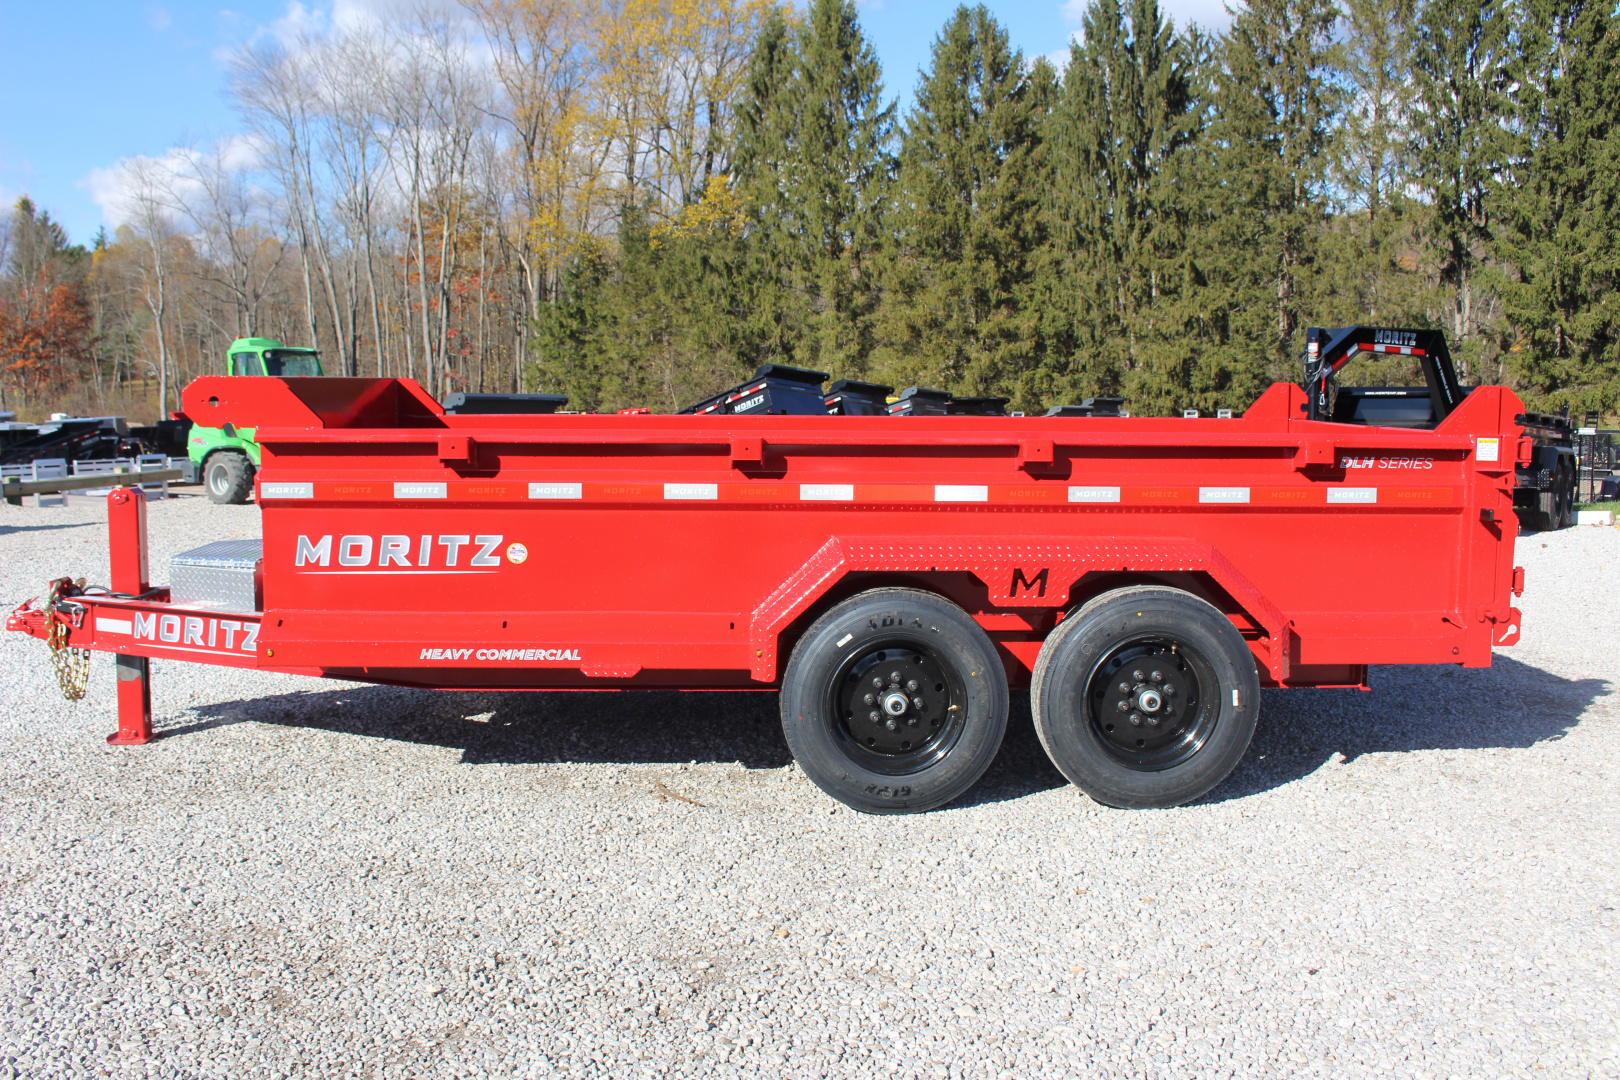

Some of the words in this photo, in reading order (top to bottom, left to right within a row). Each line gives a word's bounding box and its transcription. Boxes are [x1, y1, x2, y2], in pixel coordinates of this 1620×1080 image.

[1375, 330, 1417, 346] MORITZ
[735, 395, 764, 413] MORITZ
[1340, 457, 1376, 469] DLH
[1378, 457, 1434, 470] SERIES
[295, 535, 504, 567] MORITZ
[1009, 568, 1050, 597] M
[134, 611, 261, 651] MORITZ
[419, 648, 474, 660] HEAVY
[476, 648, 582, 660] COMMERCIAL
